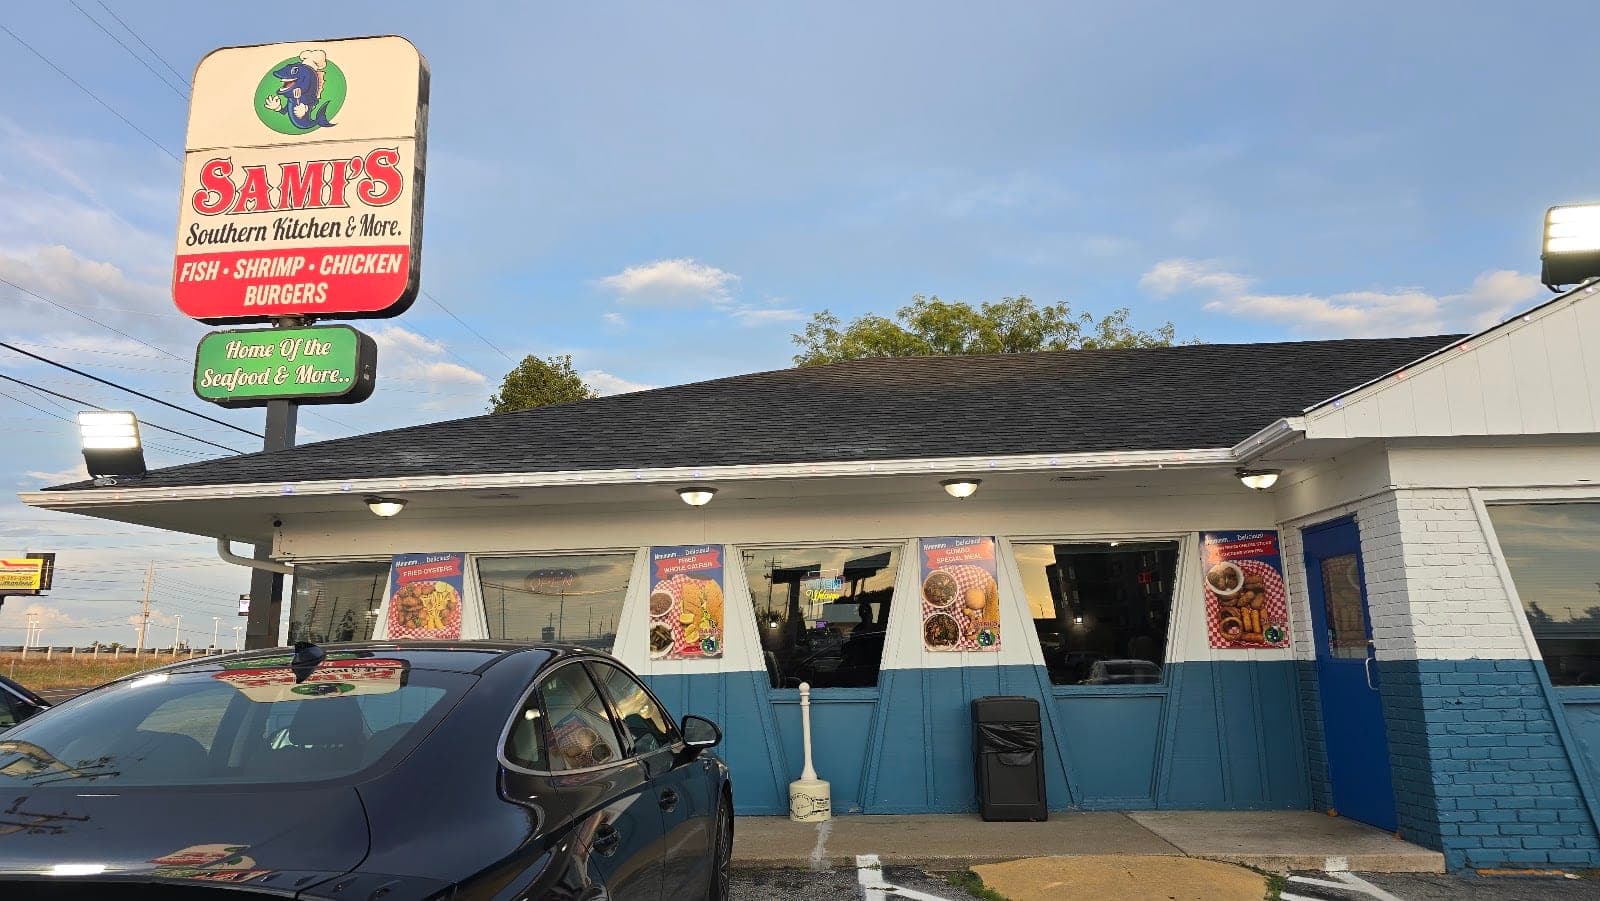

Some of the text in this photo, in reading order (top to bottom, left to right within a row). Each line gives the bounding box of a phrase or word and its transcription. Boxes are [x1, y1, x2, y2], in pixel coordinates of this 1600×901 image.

[192, 146, 404, 216] SAMI'S
[186, 213, 402, 247] Southern Kitchen & More.
[180, 253, 403, 283] FISH SHRIMP CHICKEN
[243, 282, 329, 307] BURGERS
[225, 338, 332, 362] Home Of the
[200, 367, 272, 393] Seafood
[273, 365, 290, 385] &
[403, 565, 453, 577] FRIED OYSTERS
[664, 562, 712, 573] WHOLE CATFISH
[936, 555, 963, 563] SPECIAL
